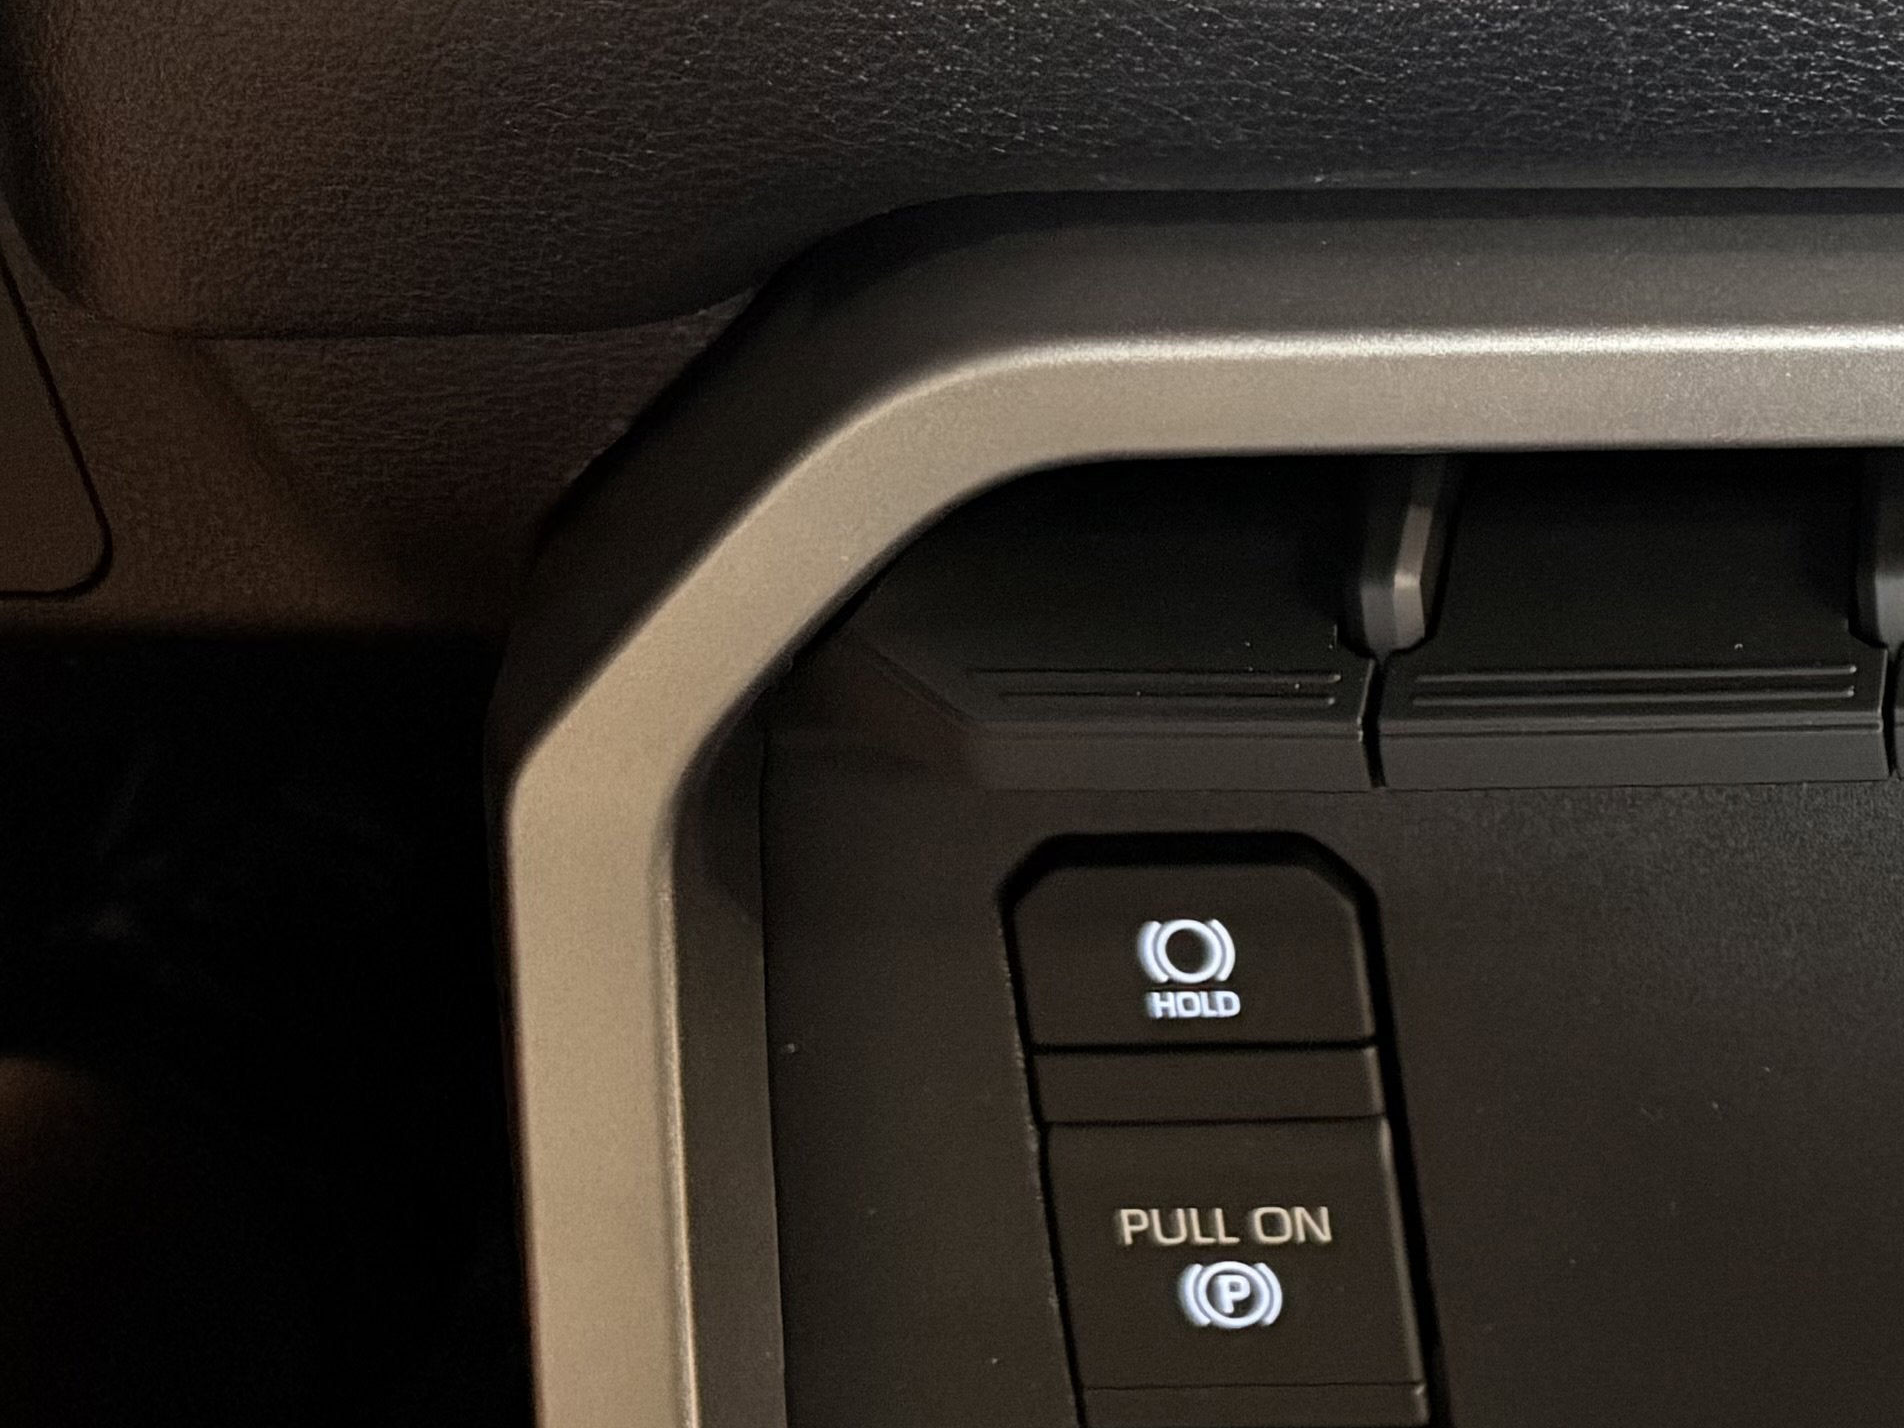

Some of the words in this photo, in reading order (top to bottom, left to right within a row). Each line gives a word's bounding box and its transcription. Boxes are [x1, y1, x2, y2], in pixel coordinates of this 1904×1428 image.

[1147, 988, 1242, 1020] HOLD
[1118, 1205, 1241, 1246] PULL
[1250, 1204, 1334, 1245] ON
[1219, 1278, 1251, 1314] P
